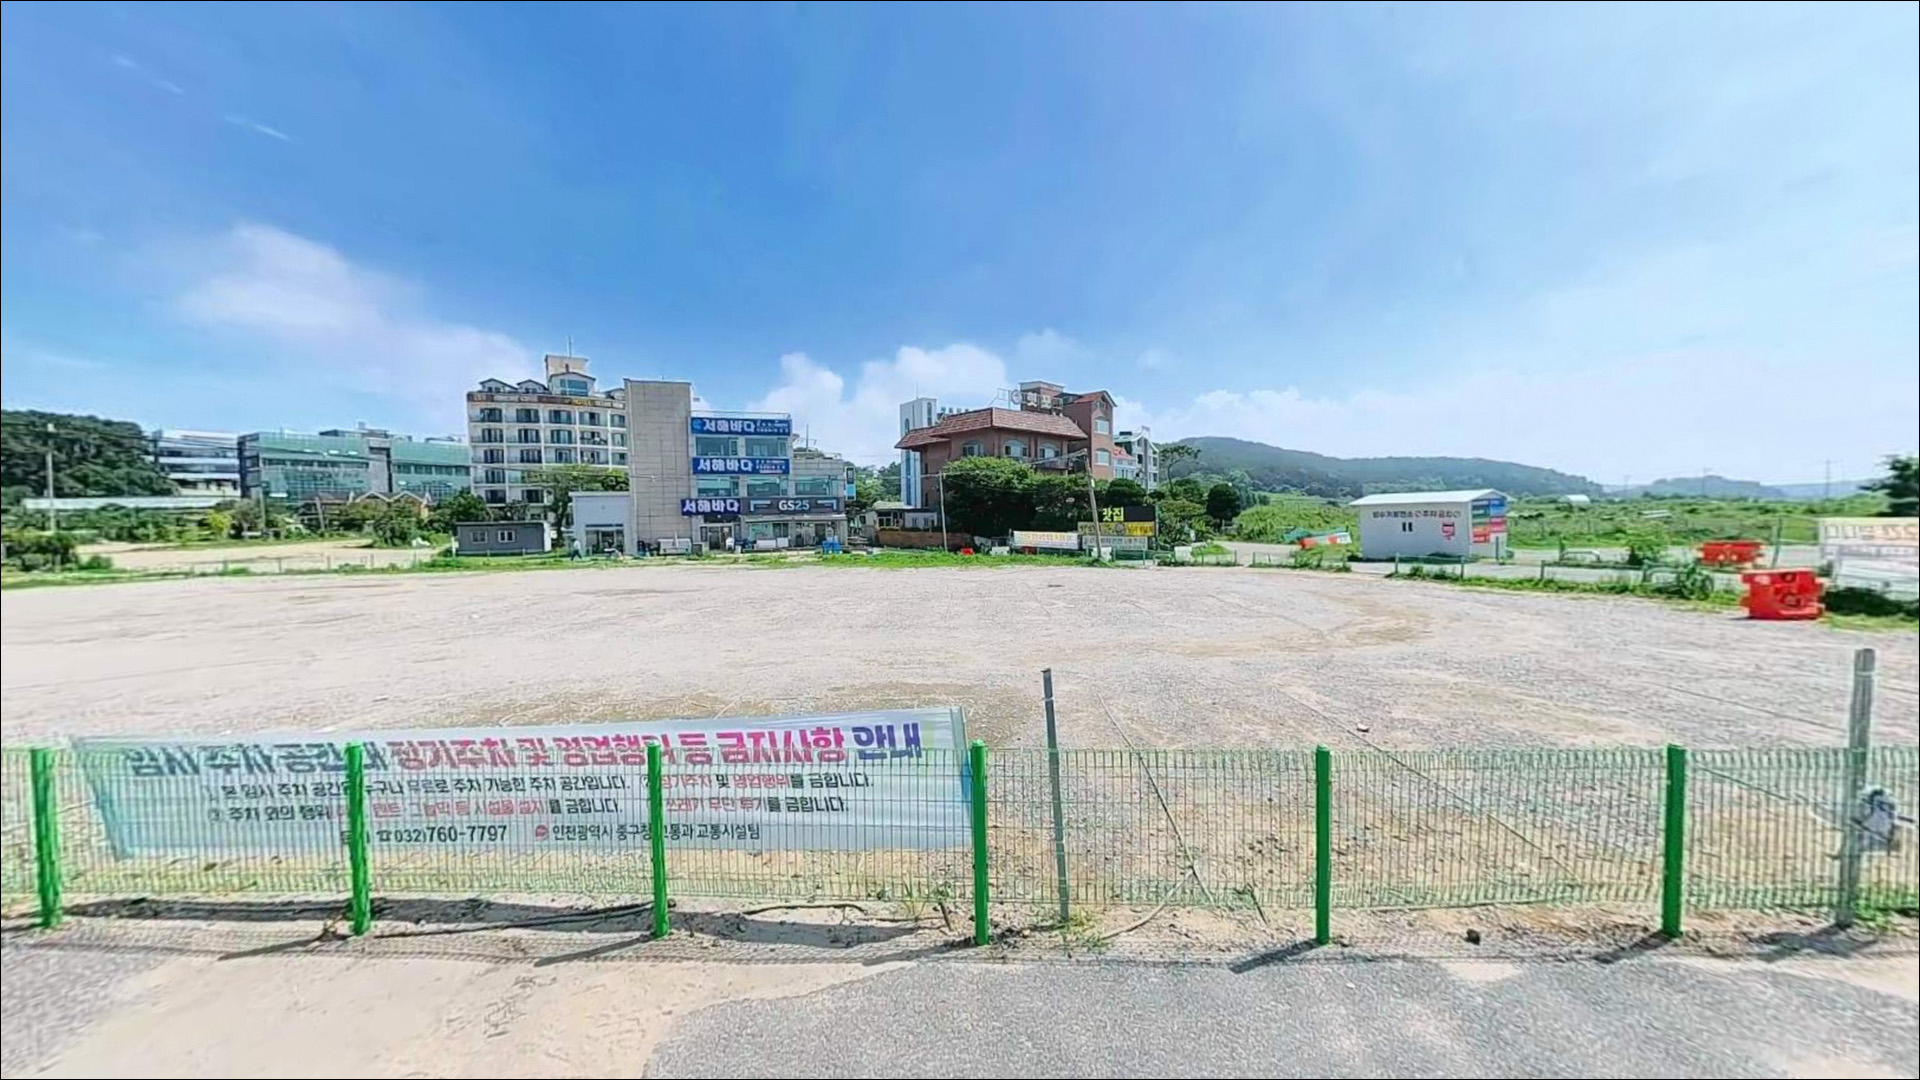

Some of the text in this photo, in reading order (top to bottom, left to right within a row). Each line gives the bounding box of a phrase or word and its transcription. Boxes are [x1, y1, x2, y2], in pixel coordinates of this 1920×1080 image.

[703, 419, 755, 432] 서해바다
[697, 458, 753, 472] 서해바다
[683, 500, 739, 513] 서해바다
[778, 500, 810, 511] GS25
[678, 733, 713, 764] 등
[716, 726, 848, 763] 금지사항
[851, 722, 922, 760] 안내
[530, 775, 557, 791] 주차
[716, 773, 731, 788] 및
[808, 771, 874, 788] 금합니다.
[786, 796, 849, 812] 금합니다.
[552, 824, 613, 842] 인천광역시
[664, 824, 694, 841] 통과
[696, 823, 760, 841] 교통시설팀
